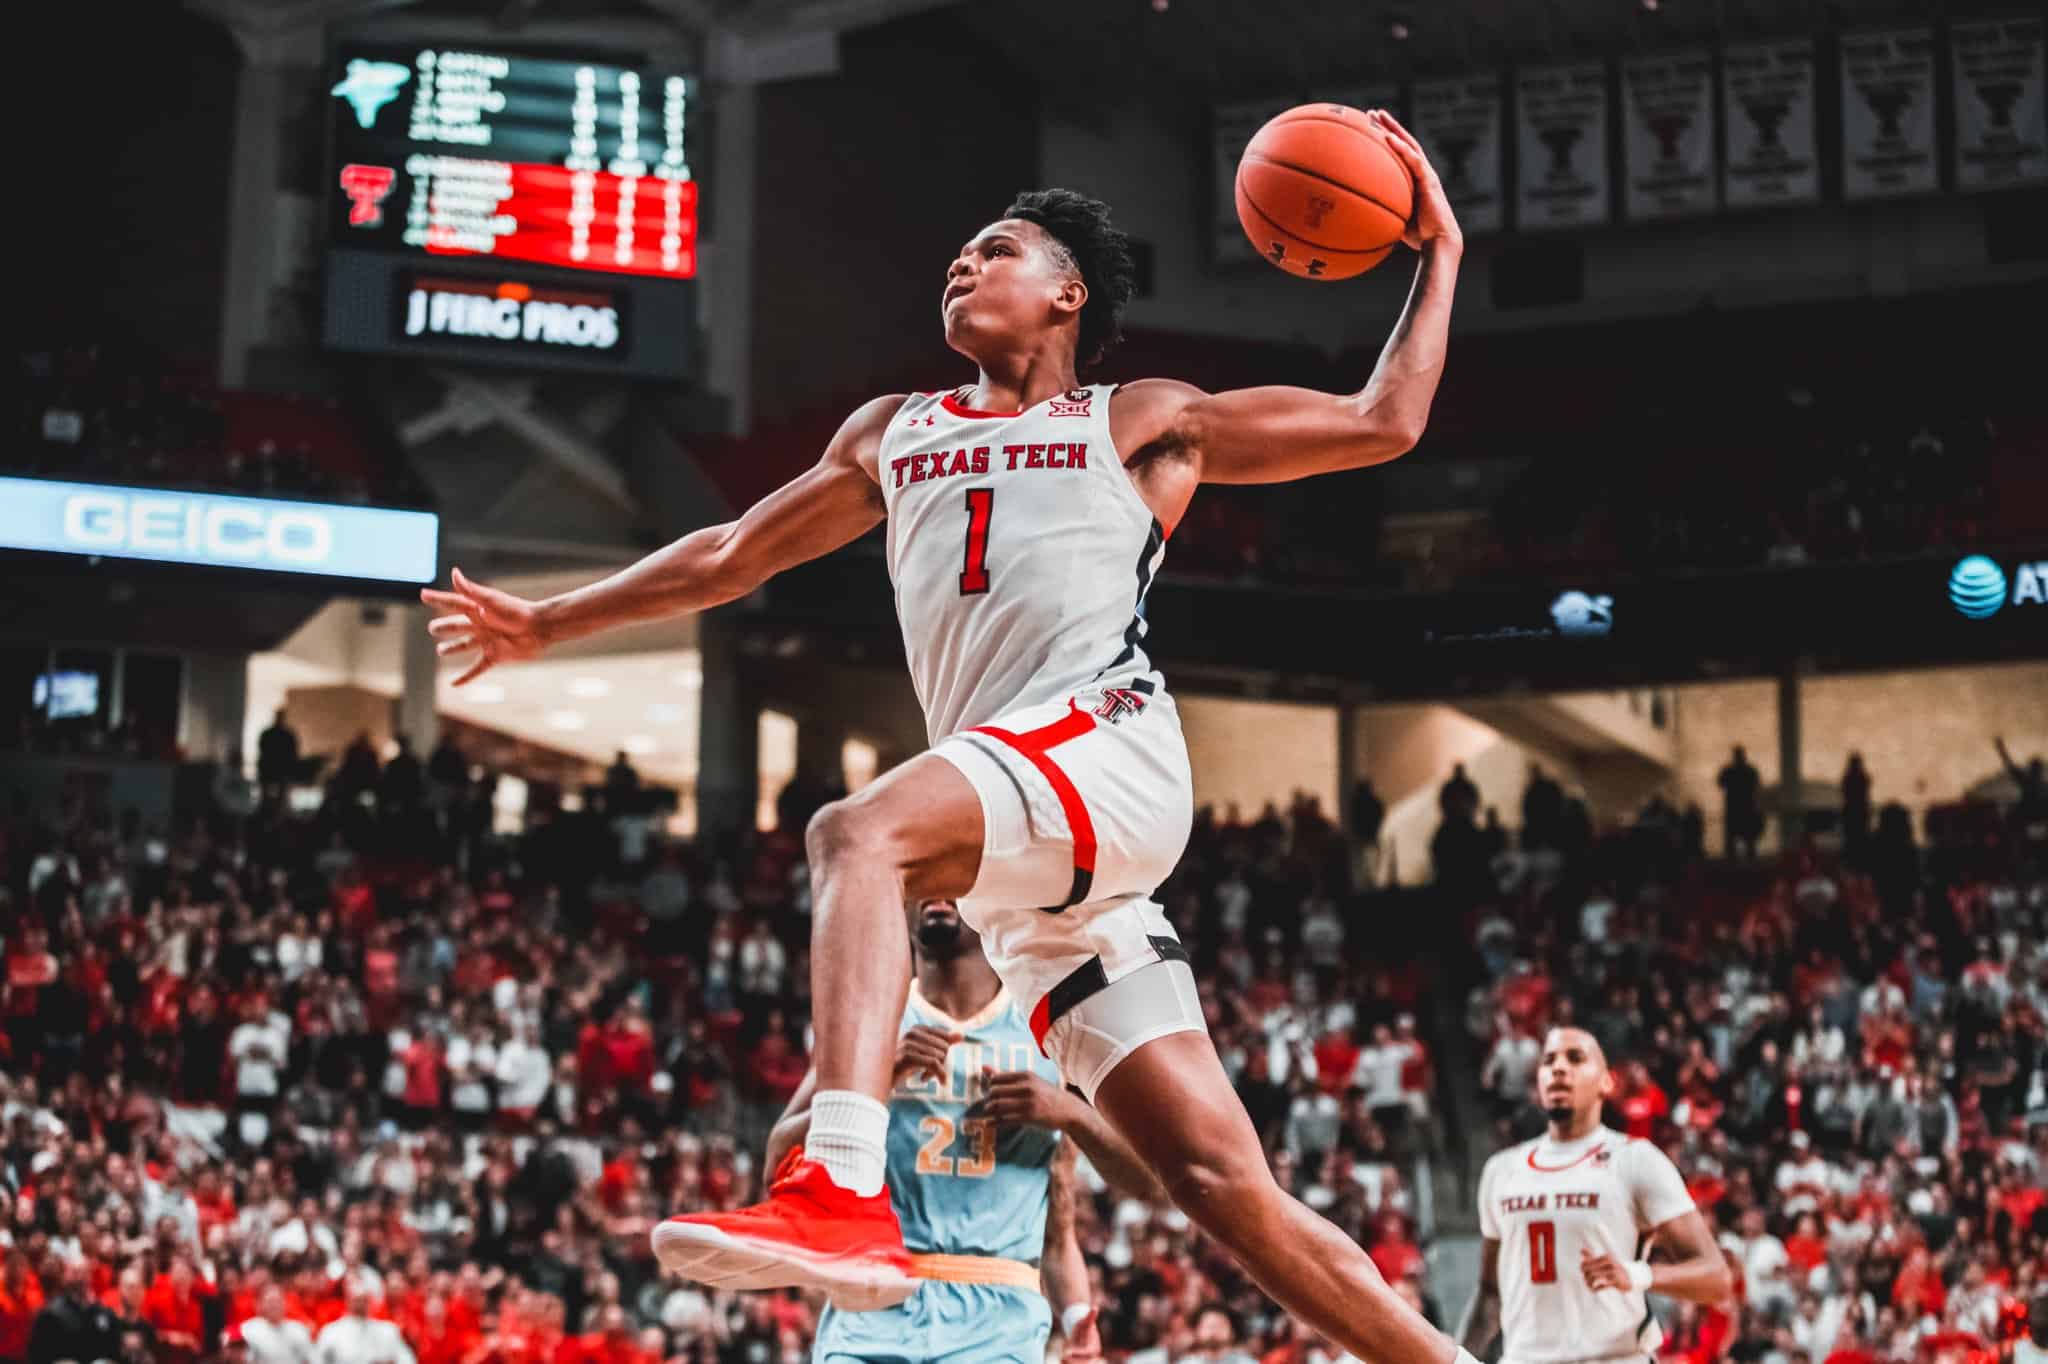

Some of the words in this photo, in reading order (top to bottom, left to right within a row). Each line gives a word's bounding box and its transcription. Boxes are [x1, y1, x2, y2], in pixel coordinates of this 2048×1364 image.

[891, 446, 990, 488] TEXAS
[1003, 443, 1088, 470] TECH
[64, 494, 332, 562] GEICO
[959, 487, 994, 597] 1
[916, 1115, 995, 1177] 23
[1501, 1193, 1547, 1214] TEXAS
[1555, 1192, 1600, 1209] TECH
[1528, 1221, 1557, 1285] 0
